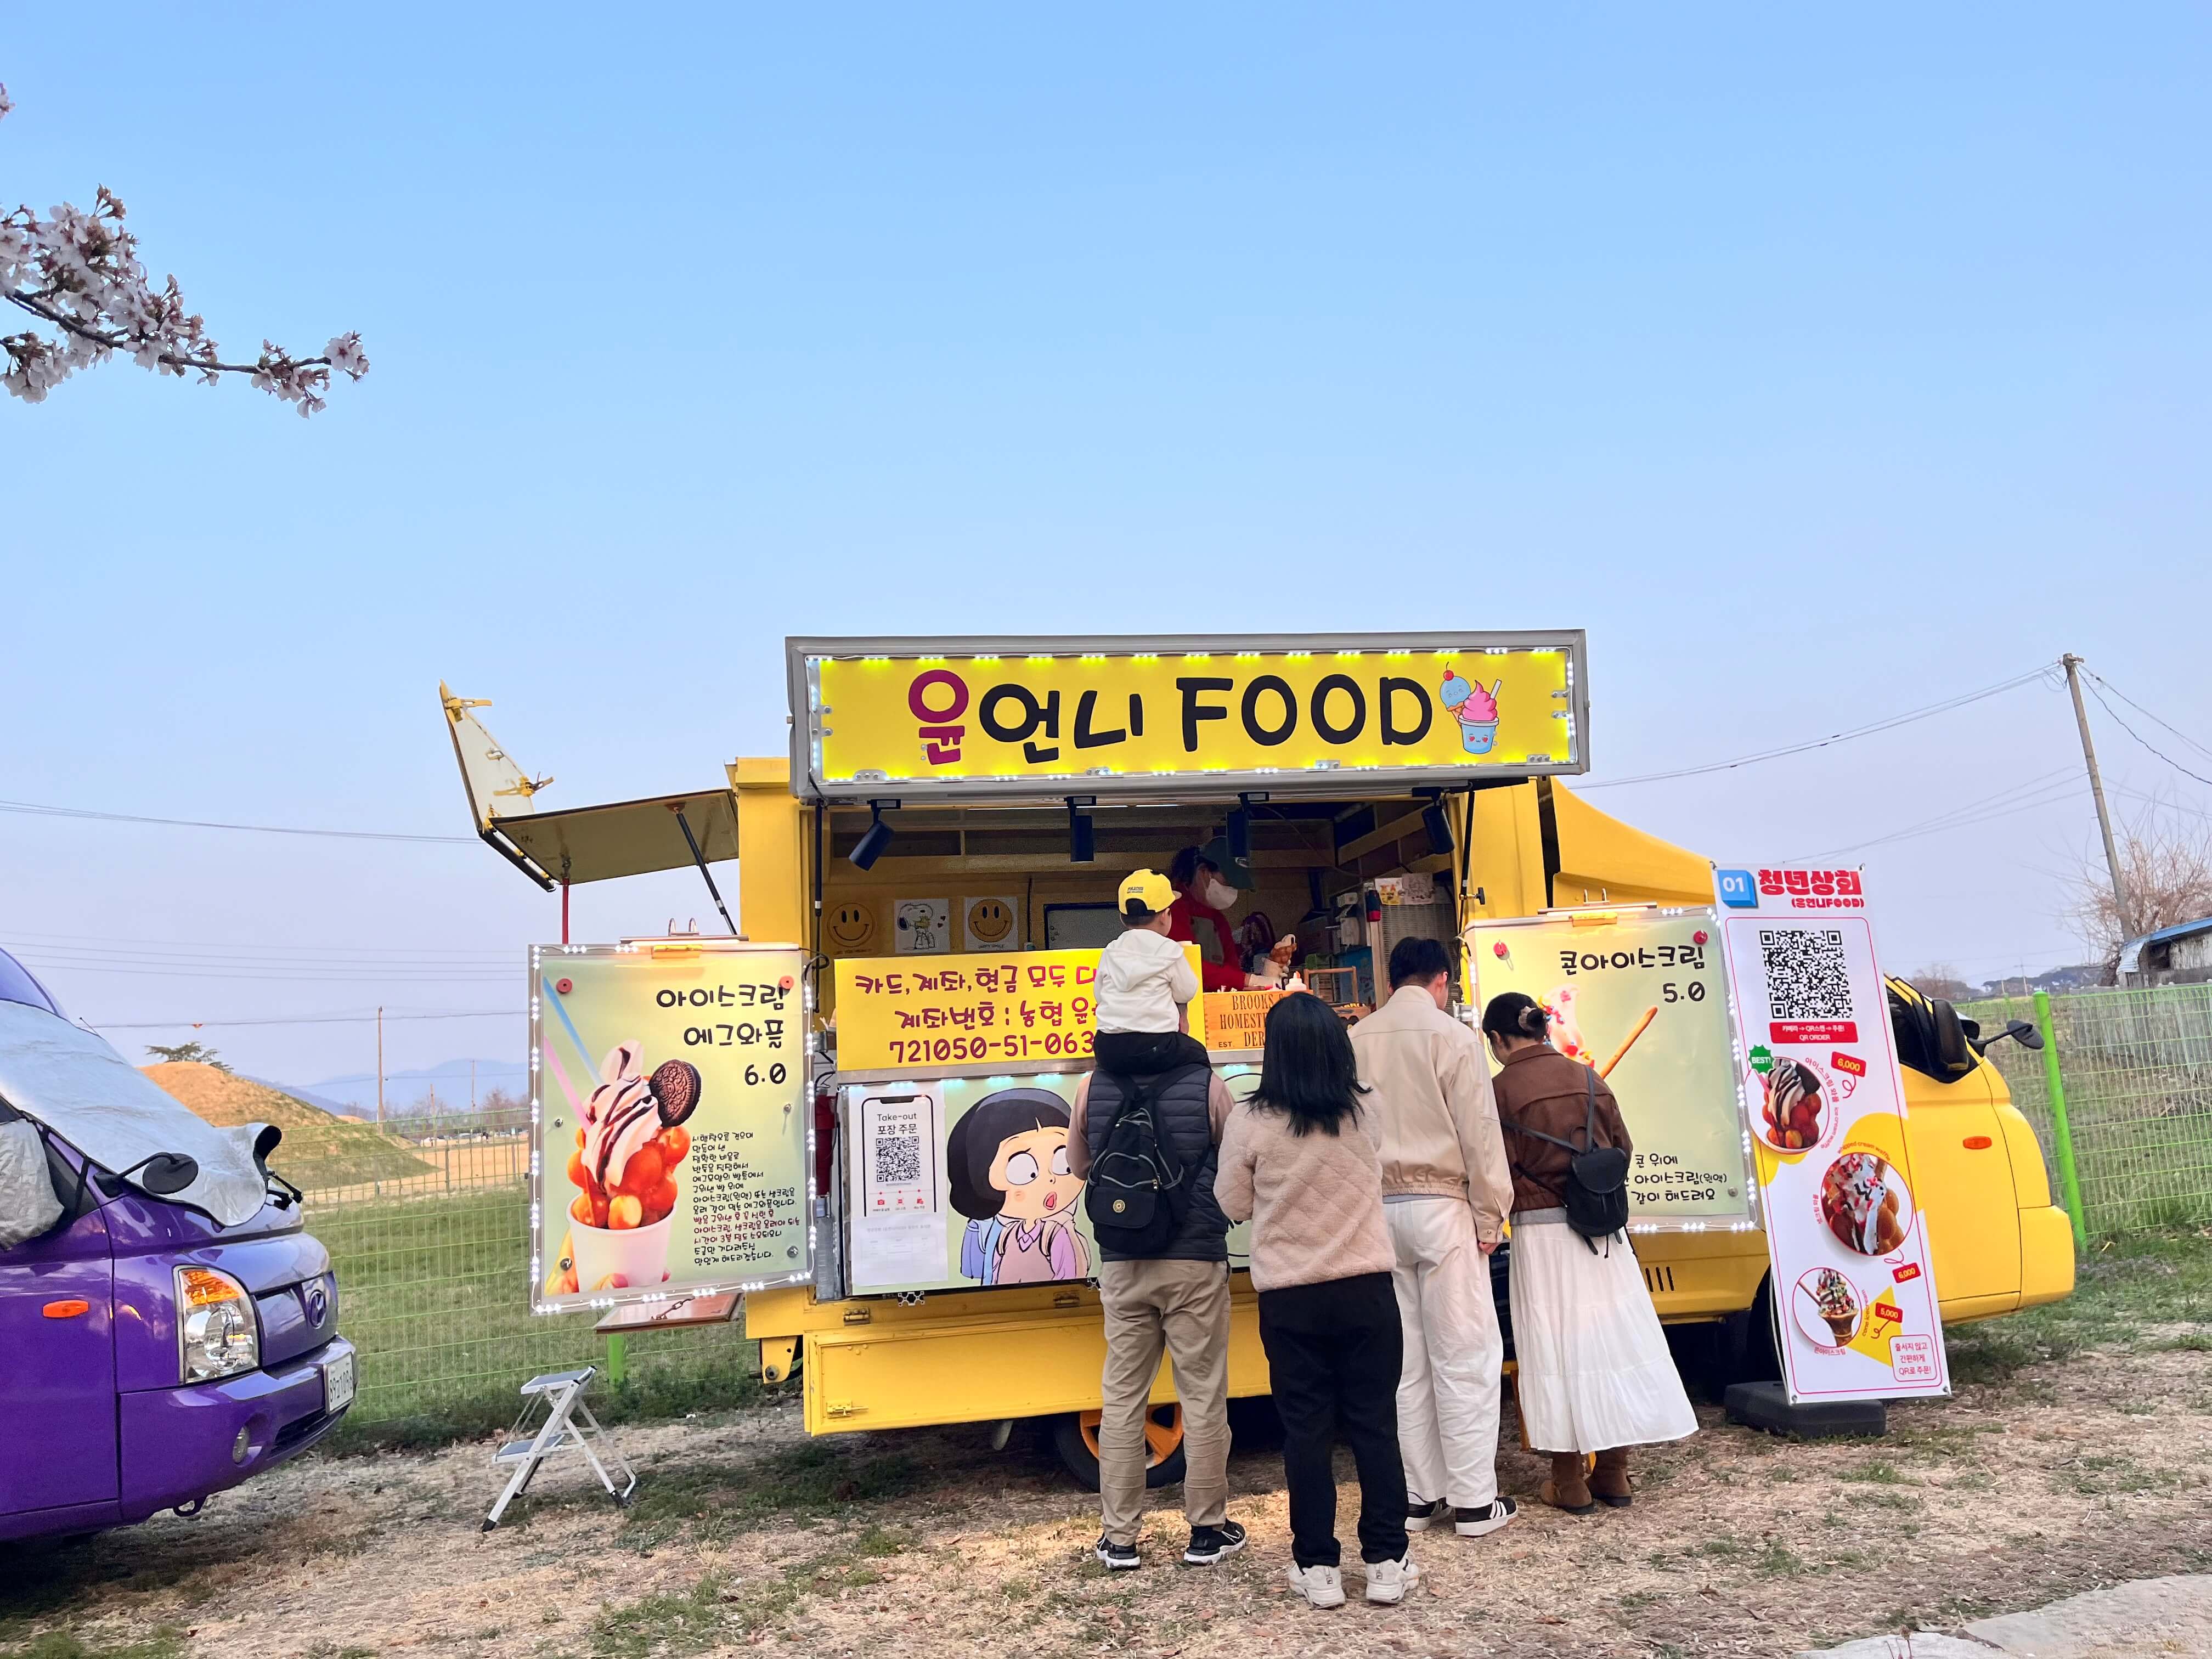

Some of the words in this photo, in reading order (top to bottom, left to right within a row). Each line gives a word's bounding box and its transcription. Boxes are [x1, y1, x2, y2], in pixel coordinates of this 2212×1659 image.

[907, 669, 1145, 766] 윤언니
[1175, 673, 1433, 752] FOOD
[1723, 877, 1745, 893] 01
[1758, 869, 1863, 895] 청년상회
[1560, 945, 1705, 975] 콘아이스크림
[1028, 966, 1066, 988] 모두
[656, 984, 784, 1011] 아이스크림
[1663, 981, 1706, 1003] 5.0
[1232, 994, 1274, 1010] BROOKS
[1020, 1000, 1062, 1028] 농협
[684, 1019, 783, 1049] 에그와플
[1837, 1058, 1860, 1072] 6,000
[744, 1063, 786, 1086] 6.0
[877, 1112, 917, 1121] Take-out
[877, 1124, 896, 1135] 포장
[899, 1124, 917, 1135] 주문
[692, 1143, 715, 1153] 만들어
[1635, 1154, 1644, 1168] 콘
[1649, 1153, 1678, 1166] 위에
[692, 1172, 730, 1182] 에그모양의
[728, 1182, 744, 1190] 위에
[1631, 1191, 1660, 1205] 같이
[1665, 1188, 1715, 1201] 해드려요
[1898, 1268, 1916, 1279] 6,000
[1880, 1308, 1899, 1319] 5,000
[1900, 1354, 1925, 1363] 간편하게
[1899, 1367, 1916, 1375] QR로
